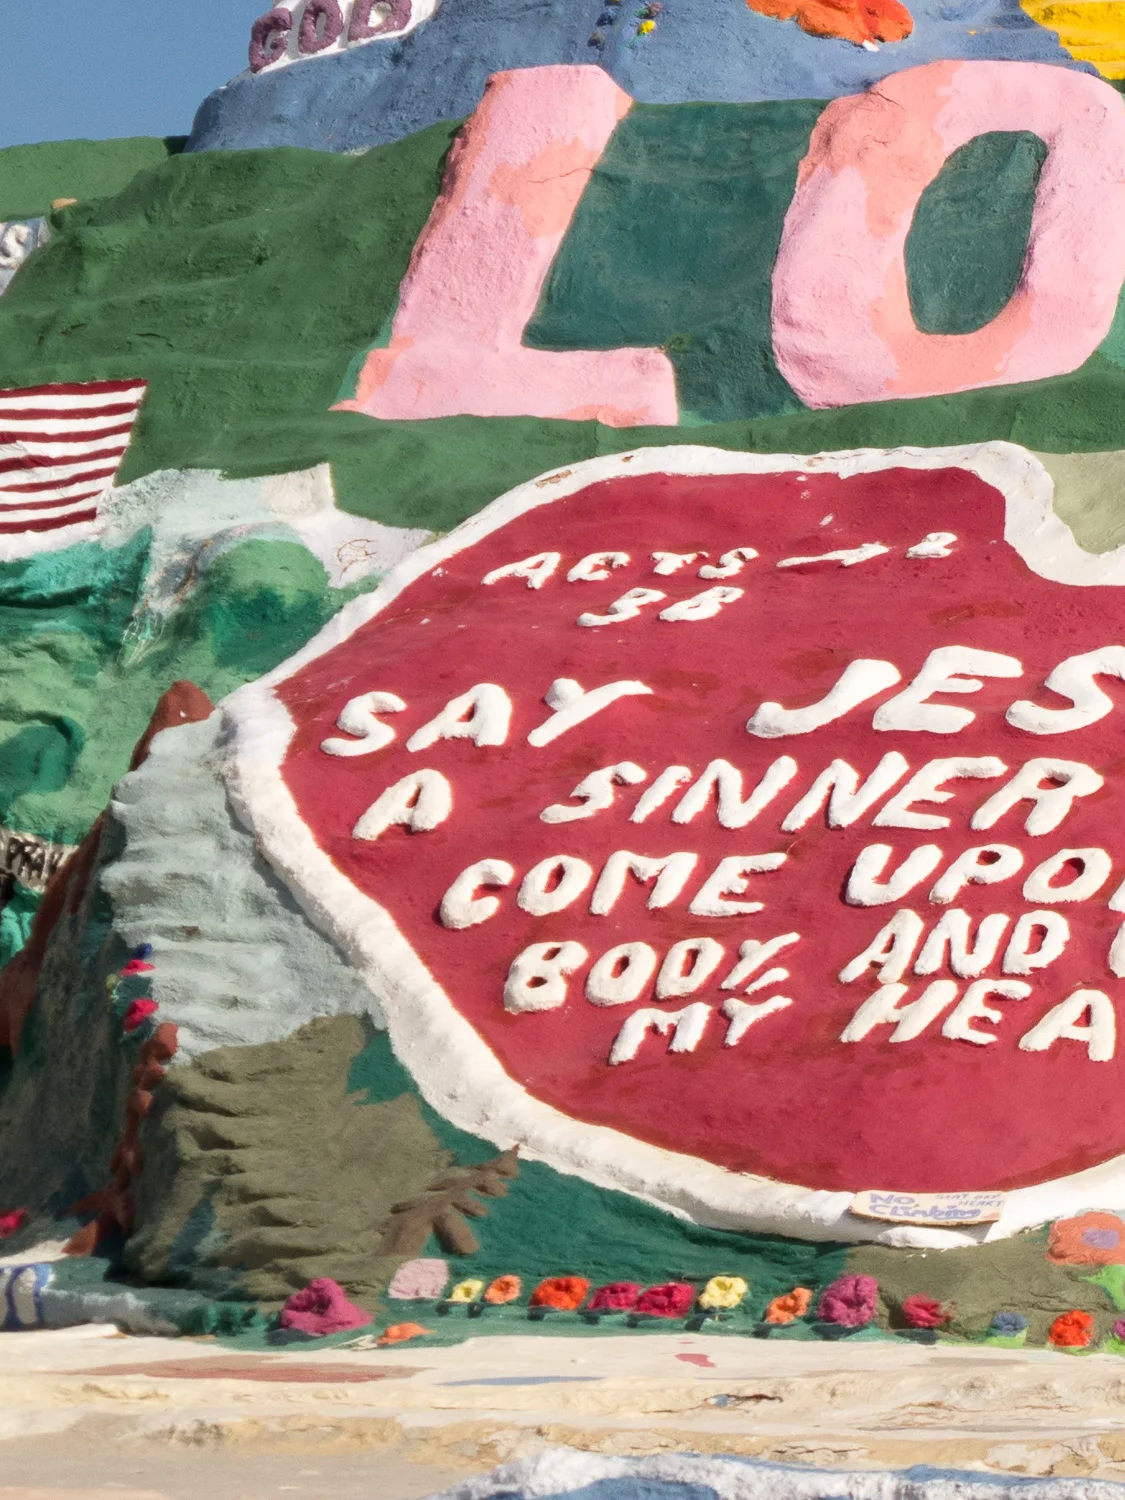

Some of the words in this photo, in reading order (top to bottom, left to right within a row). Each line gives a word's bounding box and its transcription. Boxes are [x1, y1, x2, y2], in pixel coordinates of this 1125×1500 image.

[482, 548, 759, 590] ACTS
[577, 586, 745, 627] 38
[321, 678, 654, 757] SAY
[352, 768, 454, 842] A
[539, 750, 1105, 837] SINNER
[442, 850, 788, 930] COME
[840, 908, 1071, 984] AND
[610, 995, 794, 1065] MY
